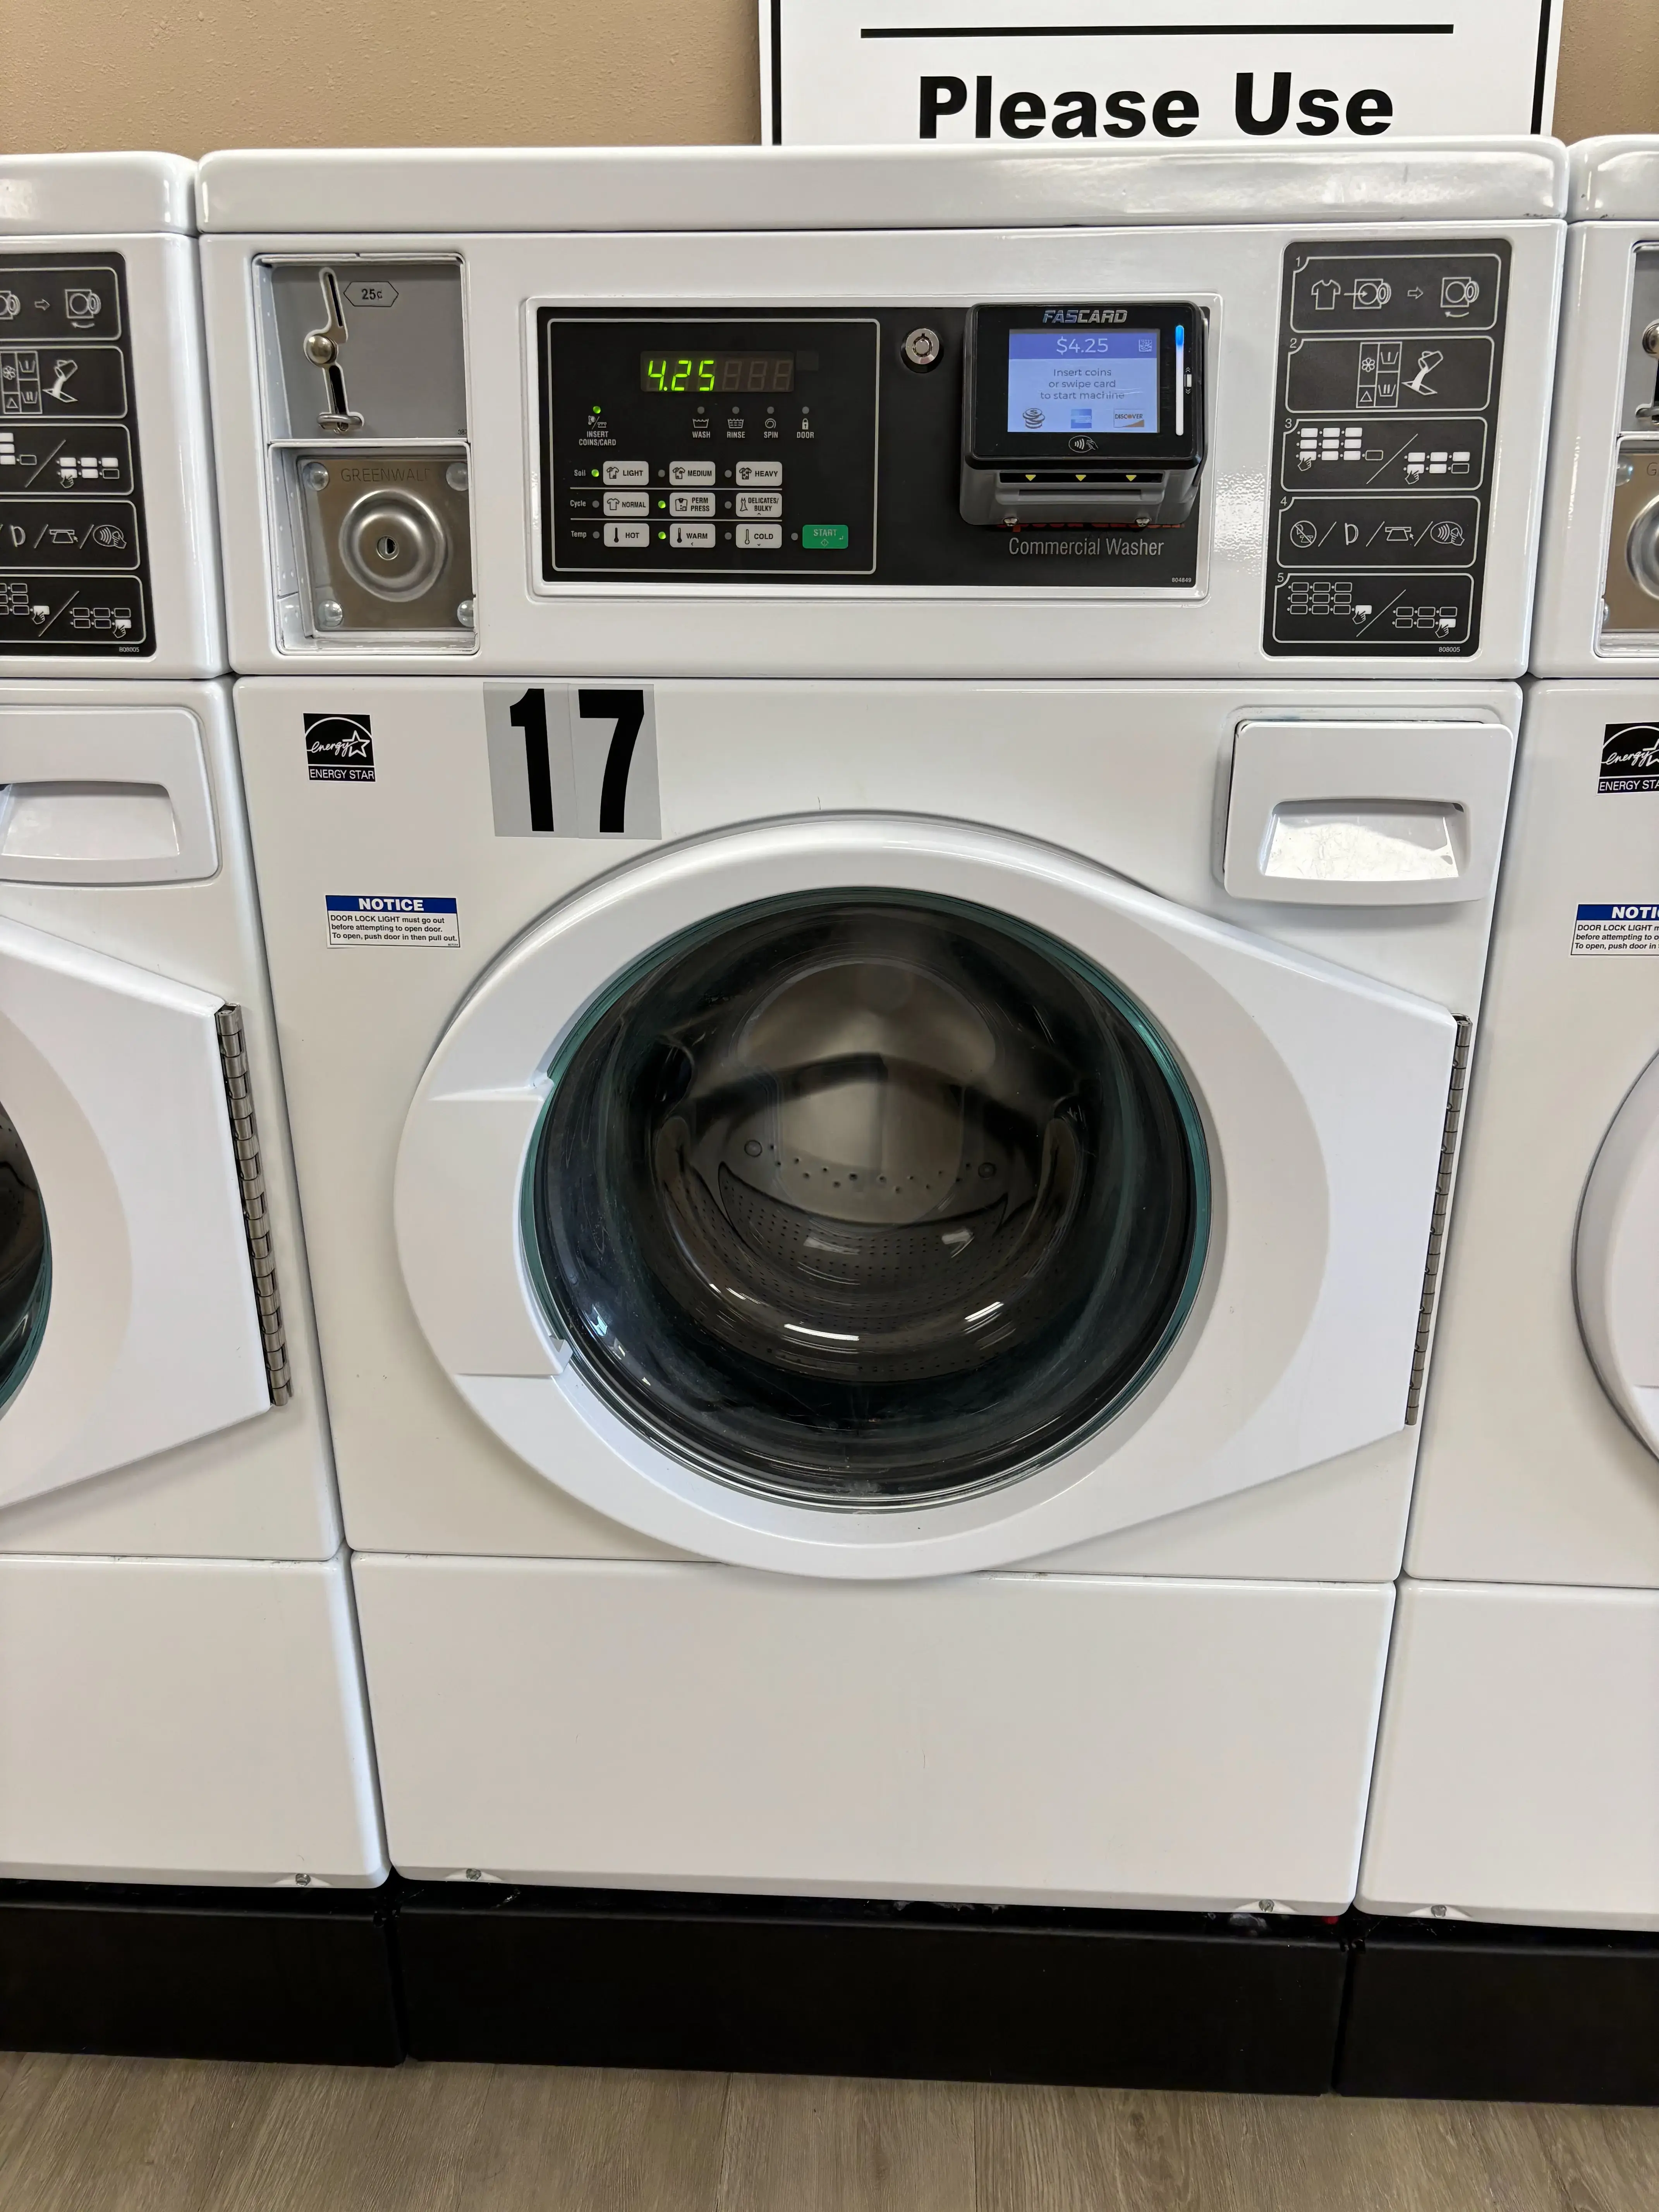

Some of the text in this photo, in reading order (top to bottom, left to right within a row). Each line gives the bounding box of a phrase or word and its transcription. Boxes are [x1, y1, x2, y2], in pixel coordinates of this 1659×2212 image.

[920, 72, 1393, 139] Please Use
[1296, 256, 1300, 267] 1
[1042, 310, 1127, 323] FASCARD
[1056, 336, 1108, 355] $4.25
[1290, 338, 1297, 348] 2
[648, 361, 715, 391] 4.25
[1062, 380, 1091, 389] swipe
[1080, 391, 1124, 399] machine
[1285, 419, 1292, 428] 3
[1280, 496, 1287, 506] 4
[571, 531, 587, 539] Temp
[1009, 538, 1164, 555] Commercial Washer
[1277, 573, 1284, 582] 5
[311, 742, 349, 757] energy
[510, 689, 644, 833] 17
[1606, 751, 1650, 767] energy
[310, 769, 374, 779] ENERGY STAR
[1599, 780, 1641, 791] ENERGY
[359, 898, 424, 911] NOTICE
